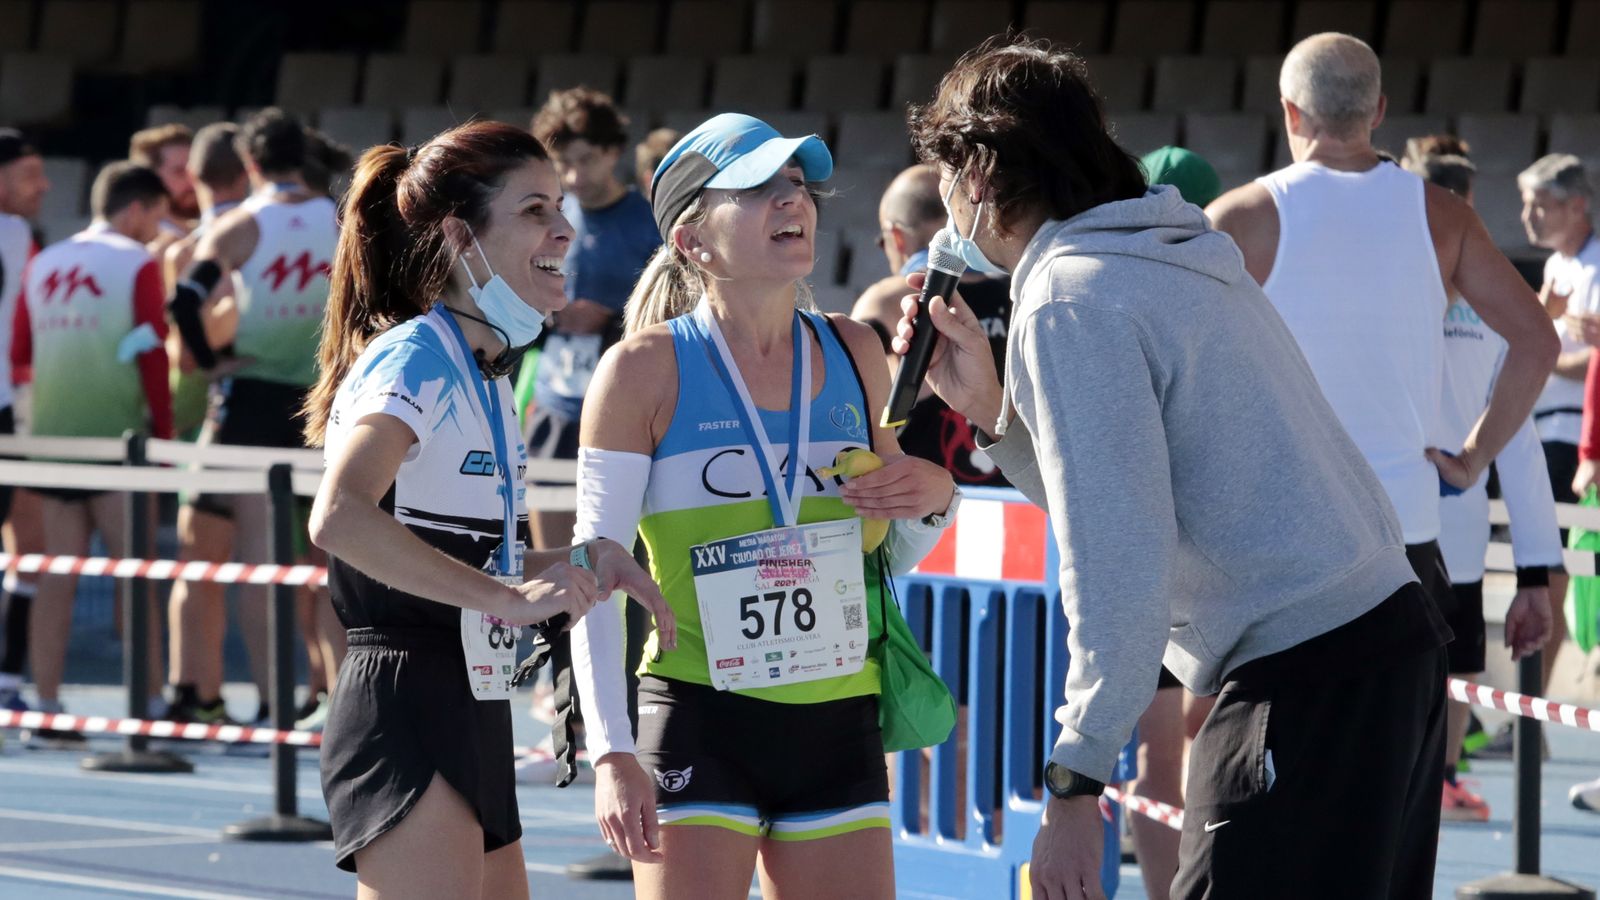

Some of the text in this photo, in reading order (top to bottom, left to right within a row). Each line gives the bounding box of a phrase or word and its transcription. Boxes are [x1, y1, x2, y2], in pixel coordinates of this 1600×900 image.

[400, 394, 424, 415] BLUE
[698, 420, 740, 432] FASTER
[695, 545, 726, 569] XXV
[765, 546, 777, 559] DE
[759, 558, 811, 568] FINISHER
[740, 587, 816, 640] 578
[737, 642, 756, 651] CLUB
[758, 636, 796, 648] ATLETISMO
